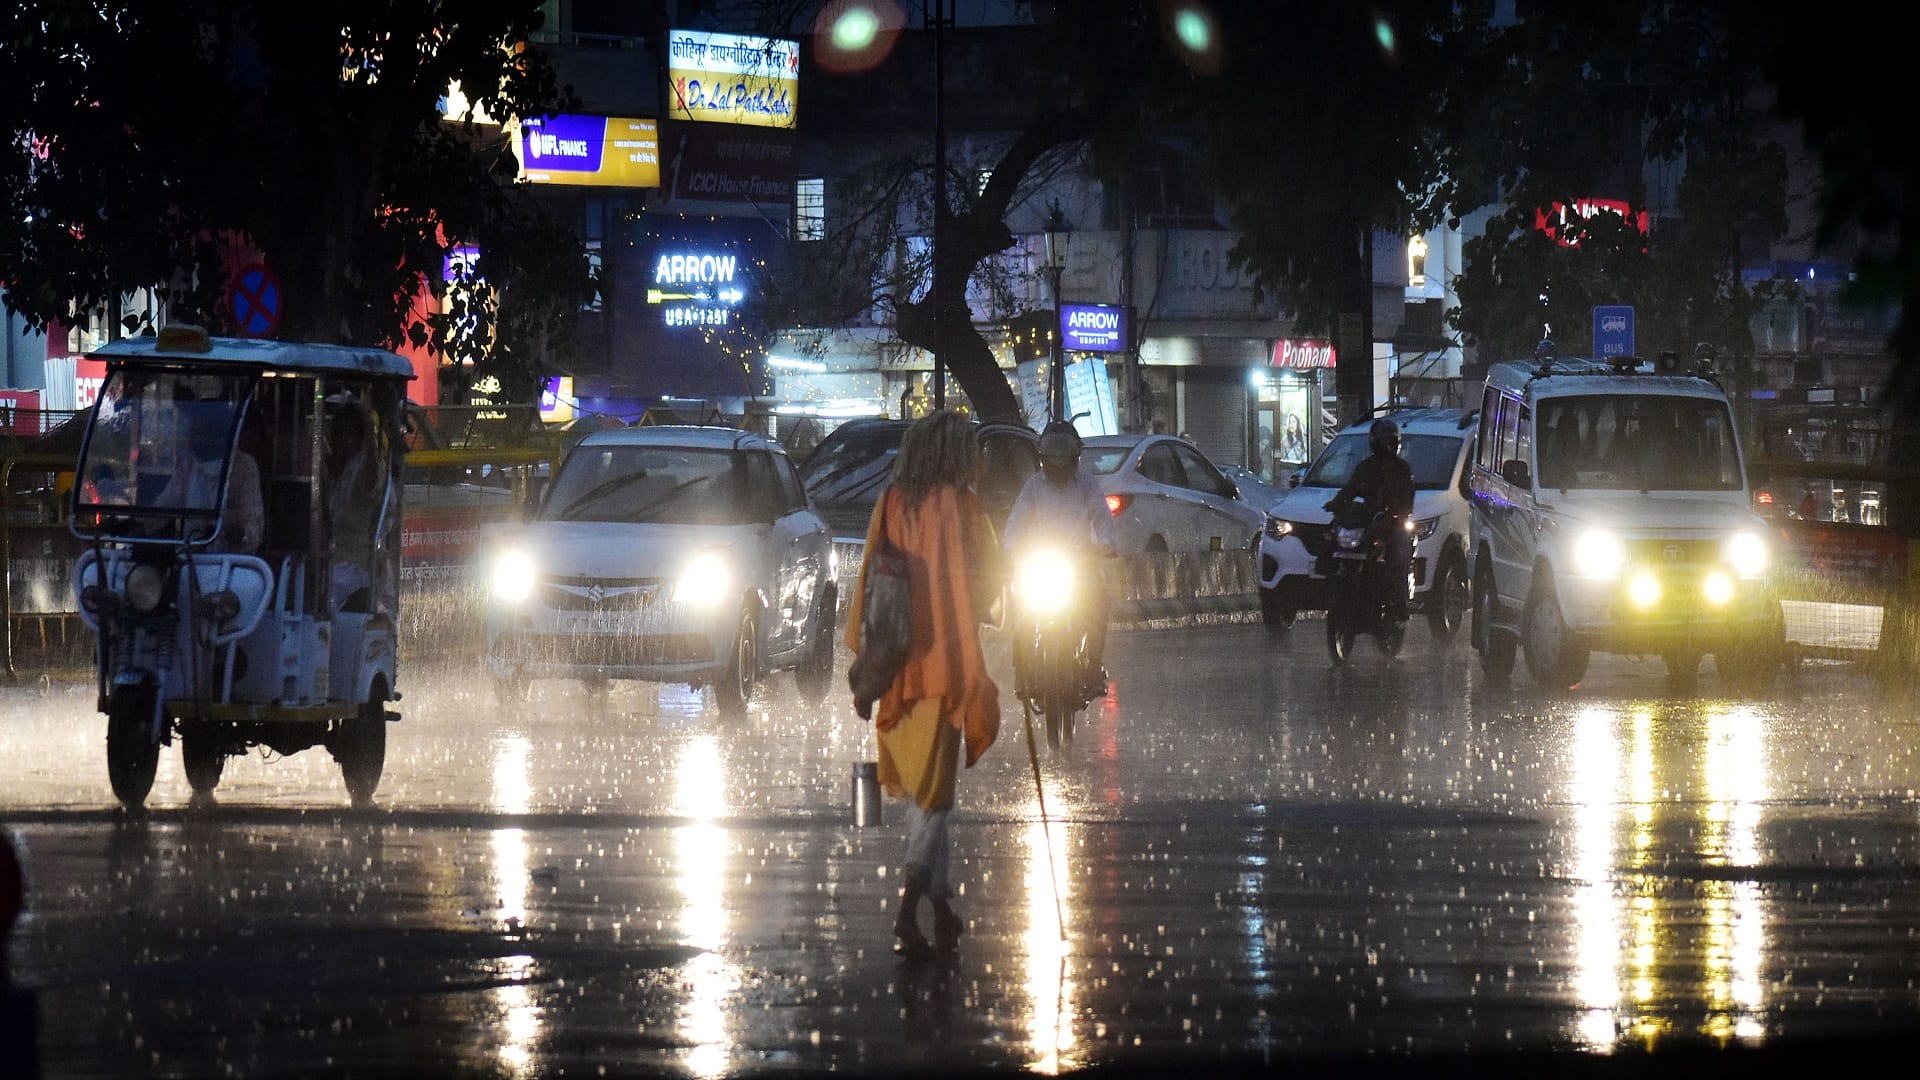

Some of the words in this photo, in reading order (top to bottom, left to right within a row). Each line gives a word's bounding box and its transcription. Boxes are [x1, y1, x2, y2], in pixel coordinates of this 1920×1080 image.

[672, 37, 706, 66] कोहिनूर
[708, 82, 732, 111] Lal
[734, 83, 791, 116] PathLabs
[559, 140, 588, 157] FINANCE
[688, 172, 718, 193] ICICI
[749, 175, 789, 196] Finance
[656, 255, 736, 284] ARROW
[1068, 311, 1119, 329] ARROW
[1280, 339, 1331, 368] Poonam
[1603, 343, 1625, 354] BUS
